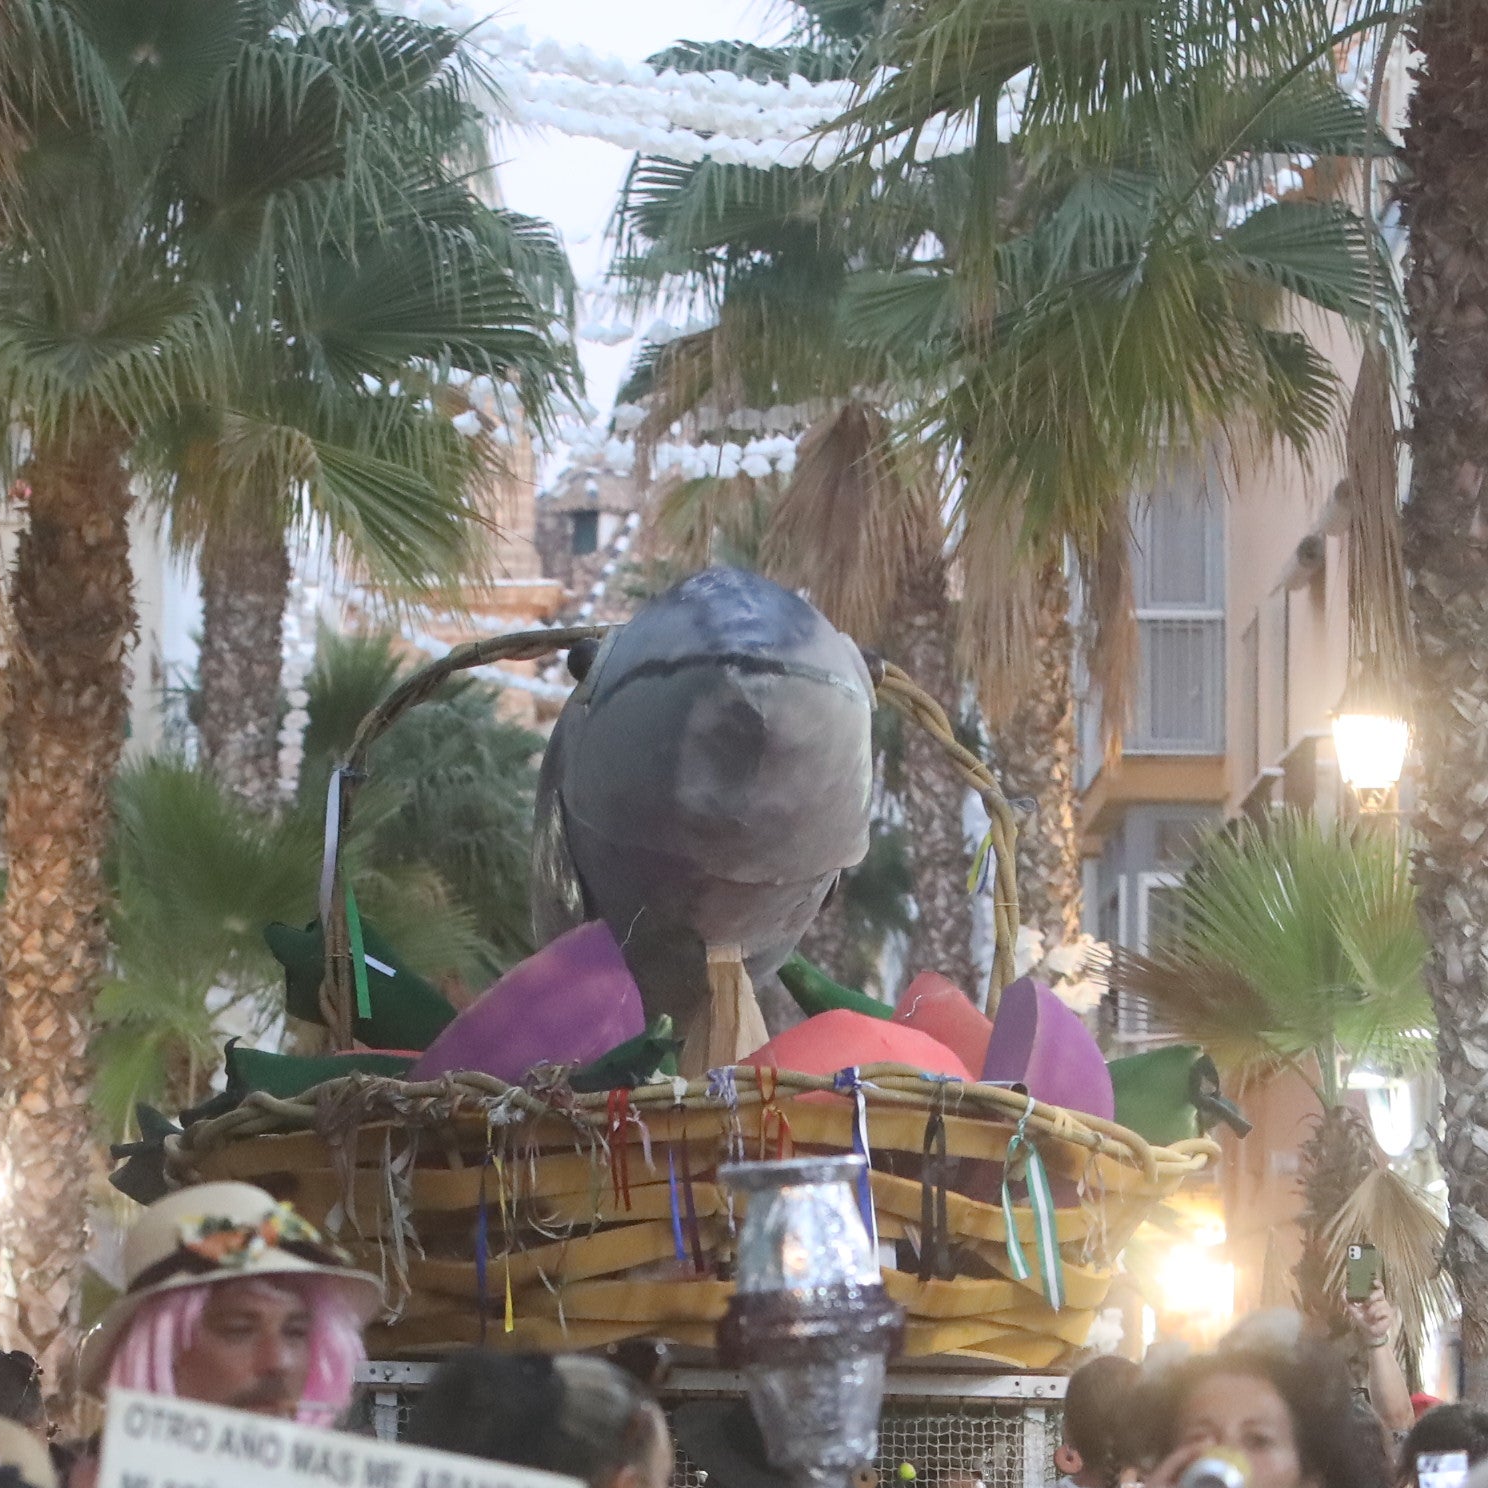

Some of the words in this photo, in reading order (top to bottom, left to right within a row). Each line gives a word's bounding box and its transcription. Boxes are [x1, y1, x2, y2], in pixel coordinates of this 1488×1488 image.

[123, 1401, 212, 1453] OTRO
[215, 1420, 285, 1470] AÑO
[289, 1441, 354, 1487] MAS
